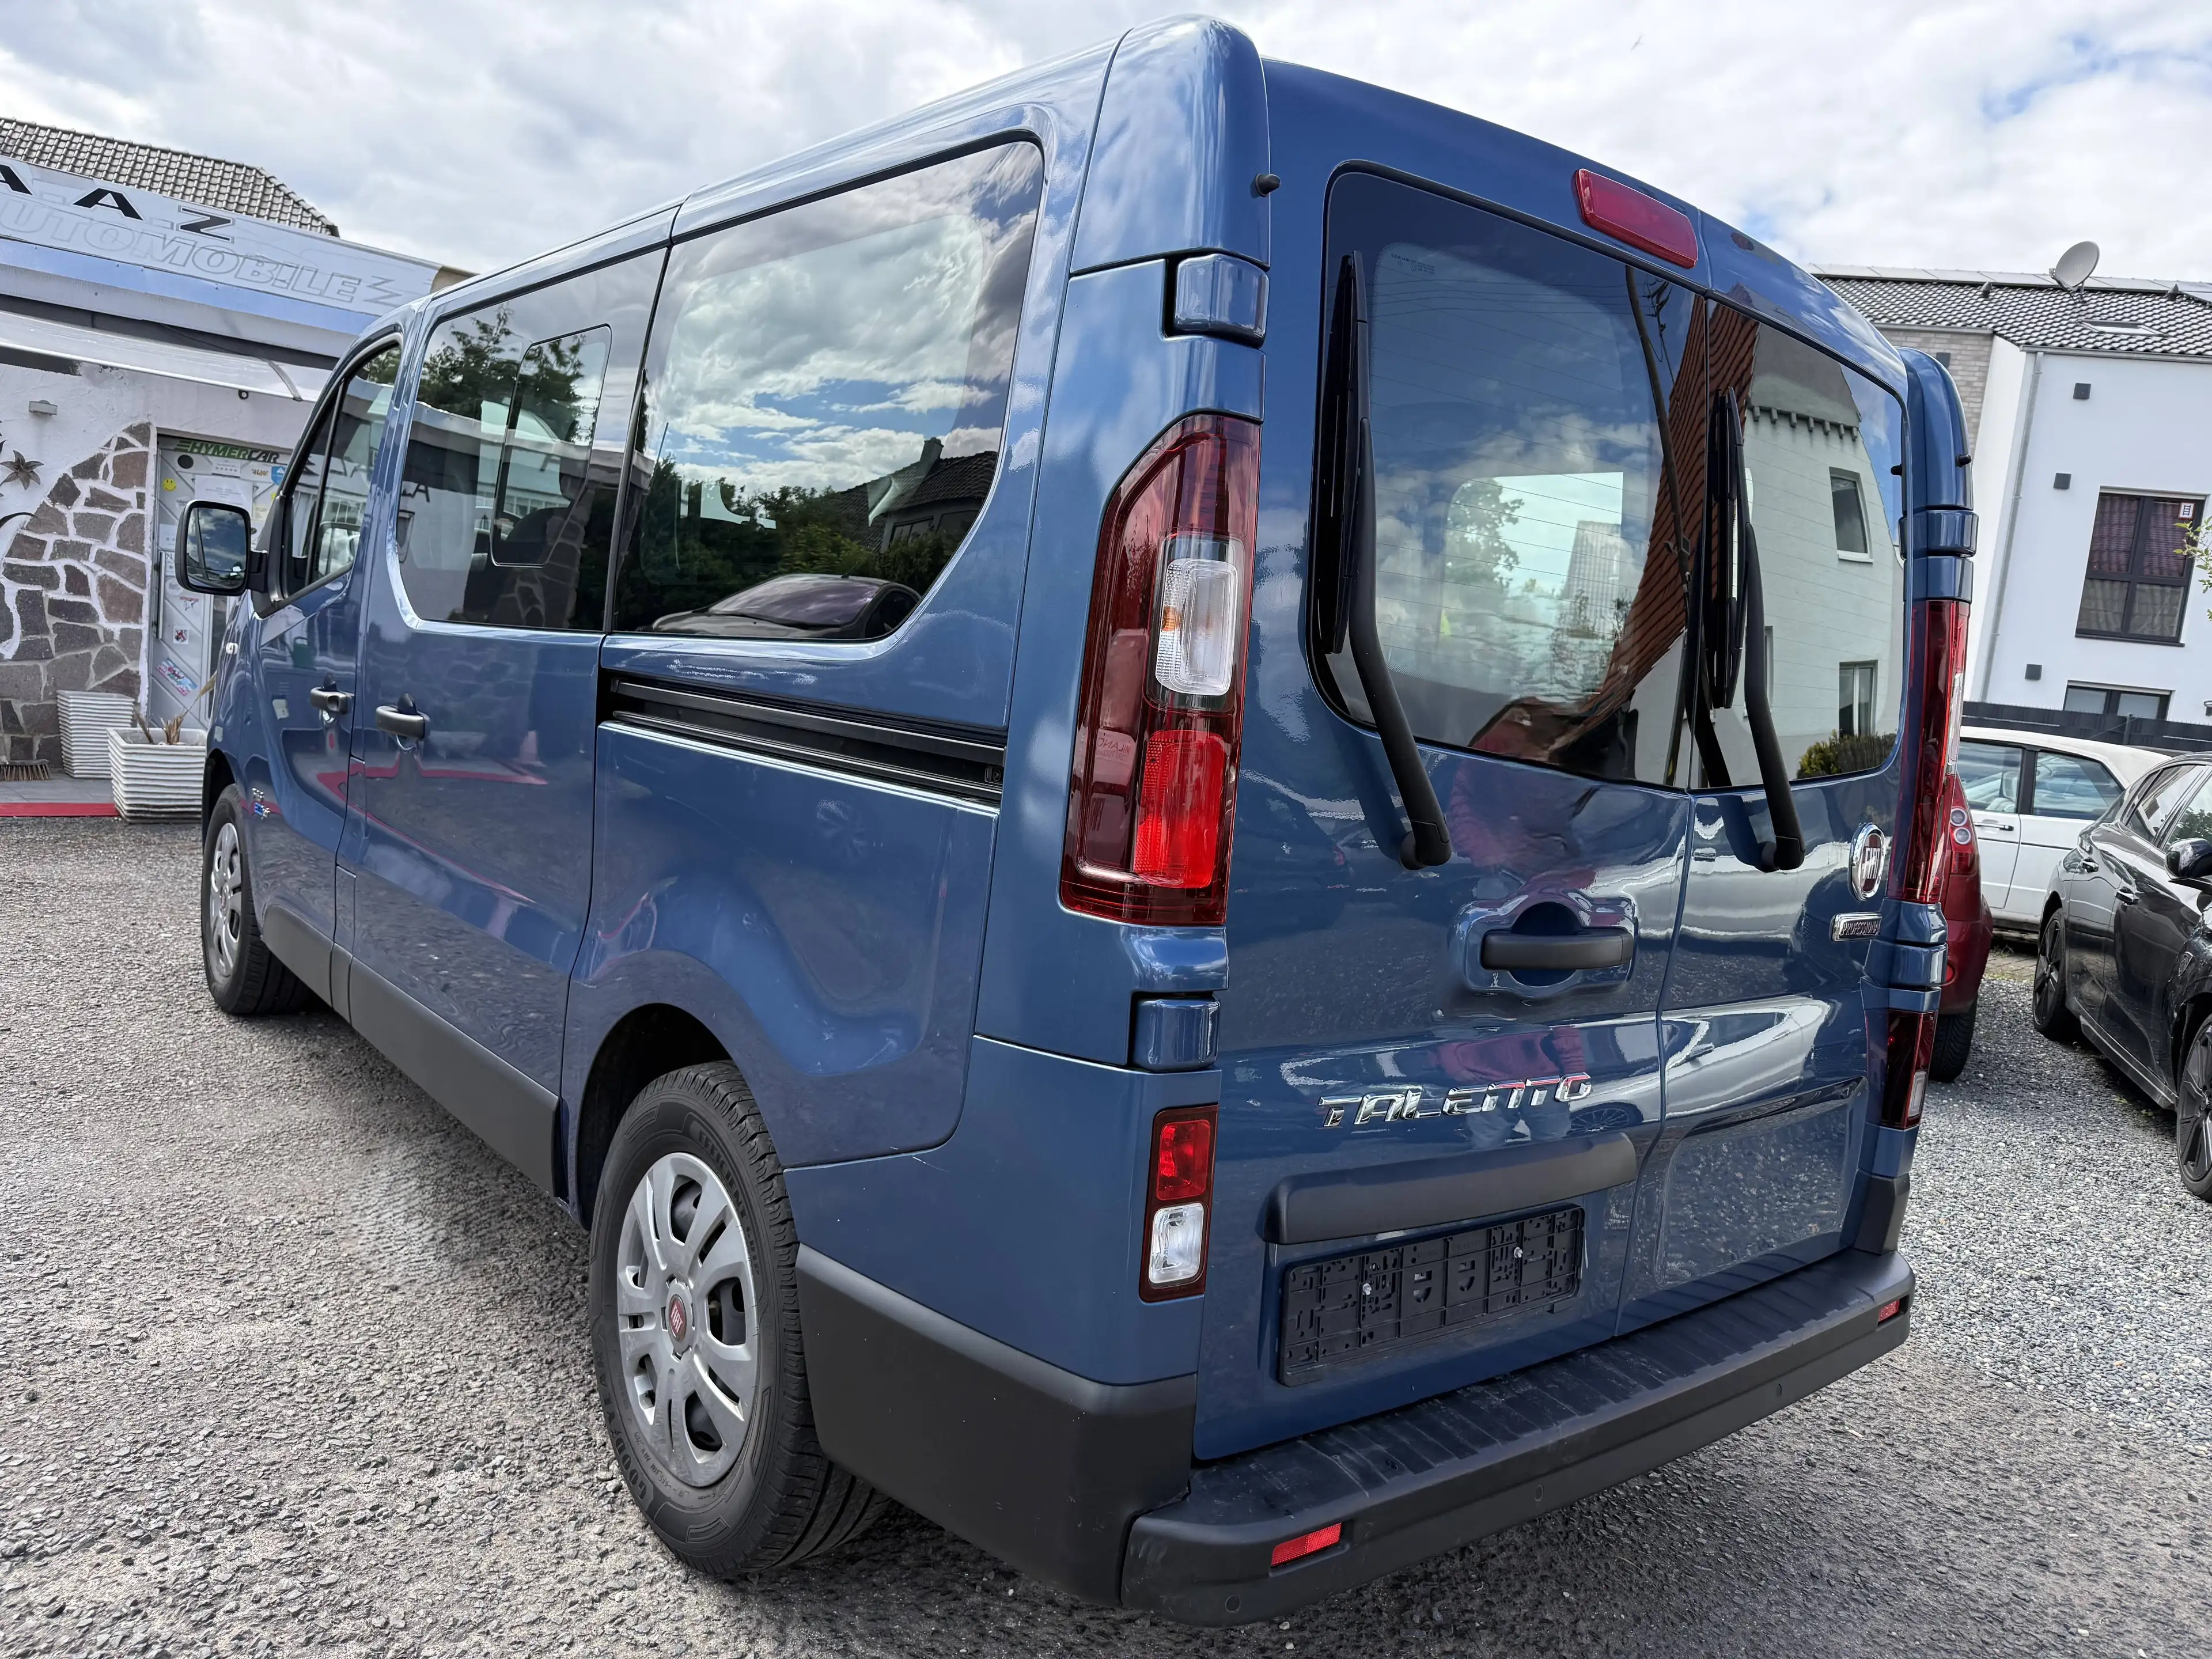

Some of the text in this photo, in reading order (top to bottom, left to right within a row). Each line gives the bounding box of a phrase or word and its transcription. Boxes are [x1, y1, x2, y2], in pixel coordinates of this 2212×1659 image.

[1863, 847, 1881, 880] FIAT
[1318, 1071, 1592, 1127] TALENTO
[671, 1304, 683, 1333] FIAT
[594, 1351, 647, 1500] GOODYEAR
